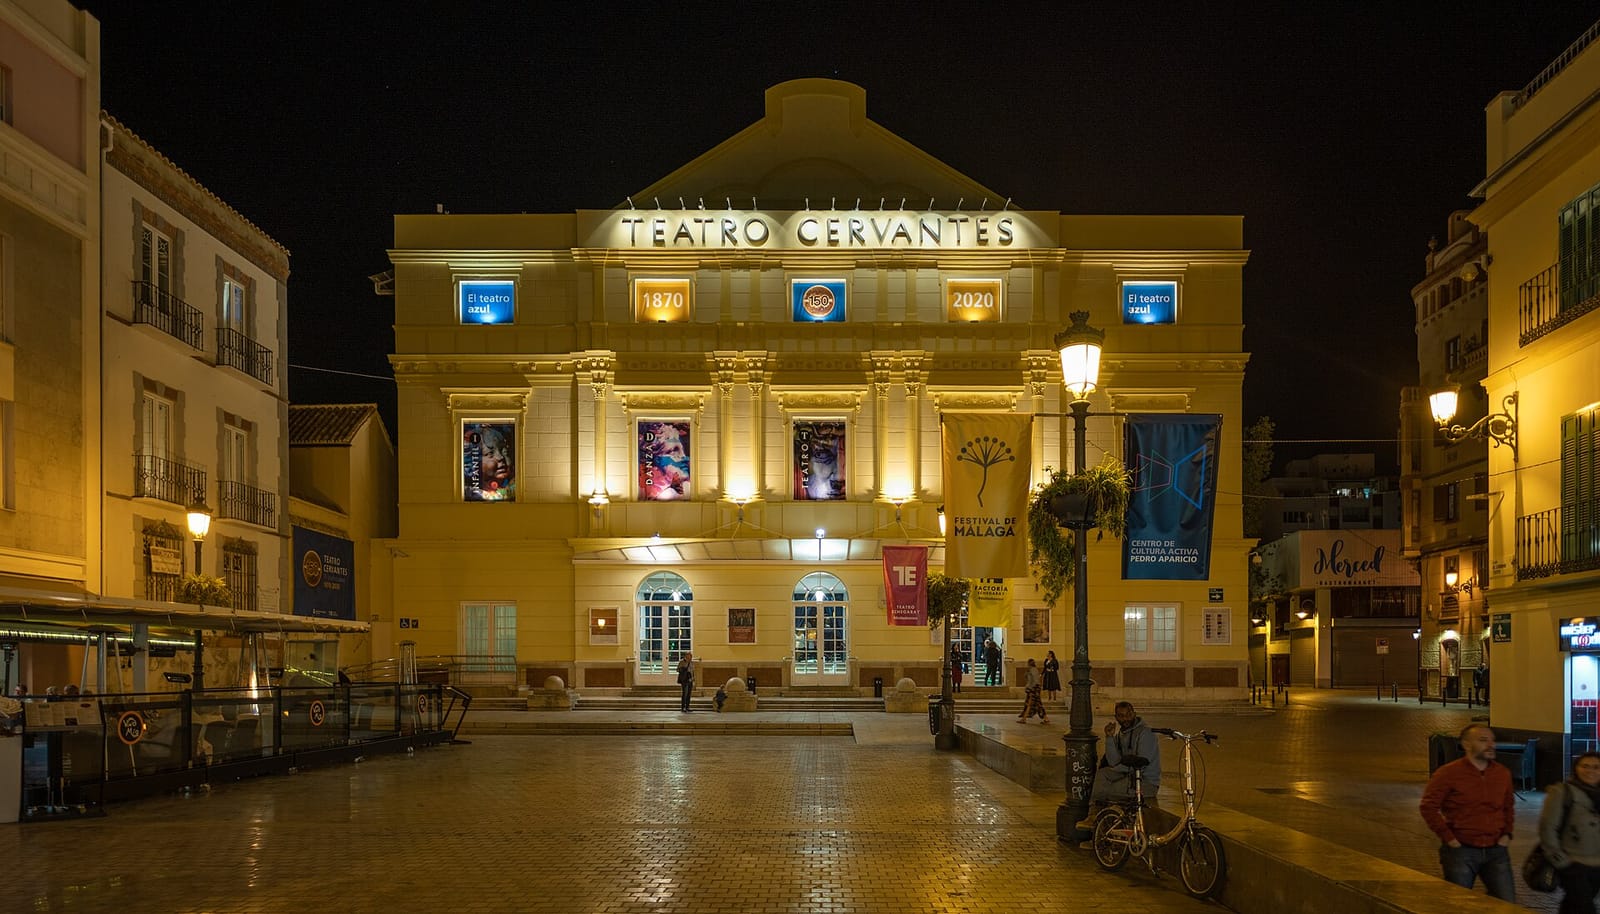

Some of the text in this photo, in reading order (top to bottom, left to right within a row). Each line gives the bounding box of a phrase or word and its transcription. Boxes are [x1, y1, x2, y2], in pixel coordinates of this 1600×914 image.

[622, 217, 1013, 246] TEATRO CERVANTES
[467, 293, 510, 303] El teatro
[643, 292, 683, 308] 1870
[808, 295, 829, 307] 150
[952, 292, 994, 308] 2020
[1128, 293, 1170, 303] El teatro
[467, 304, 490, 314] azul
[1128, 304, 1151, 314] azul
[646, 432, 655, 441] D
[801, 431, 809, 440] T
[472, 446, 480, 494] INFANTIL
[645, 443, 654, 486] DANZA
[801, 443, 809, 489] TEATRO
[954, 517, 1017, 525] FESTIVAL DE
[1131, 547, 1199, 556] CULTURA ACTIVA
[323, 555, 341, 566] TEATRO
[1130, 555, 1198, 563] PEDRO APARICIO
[1314, 540, 1385, 577] Merced
[323, 564, 348, 576] CERVANTES
